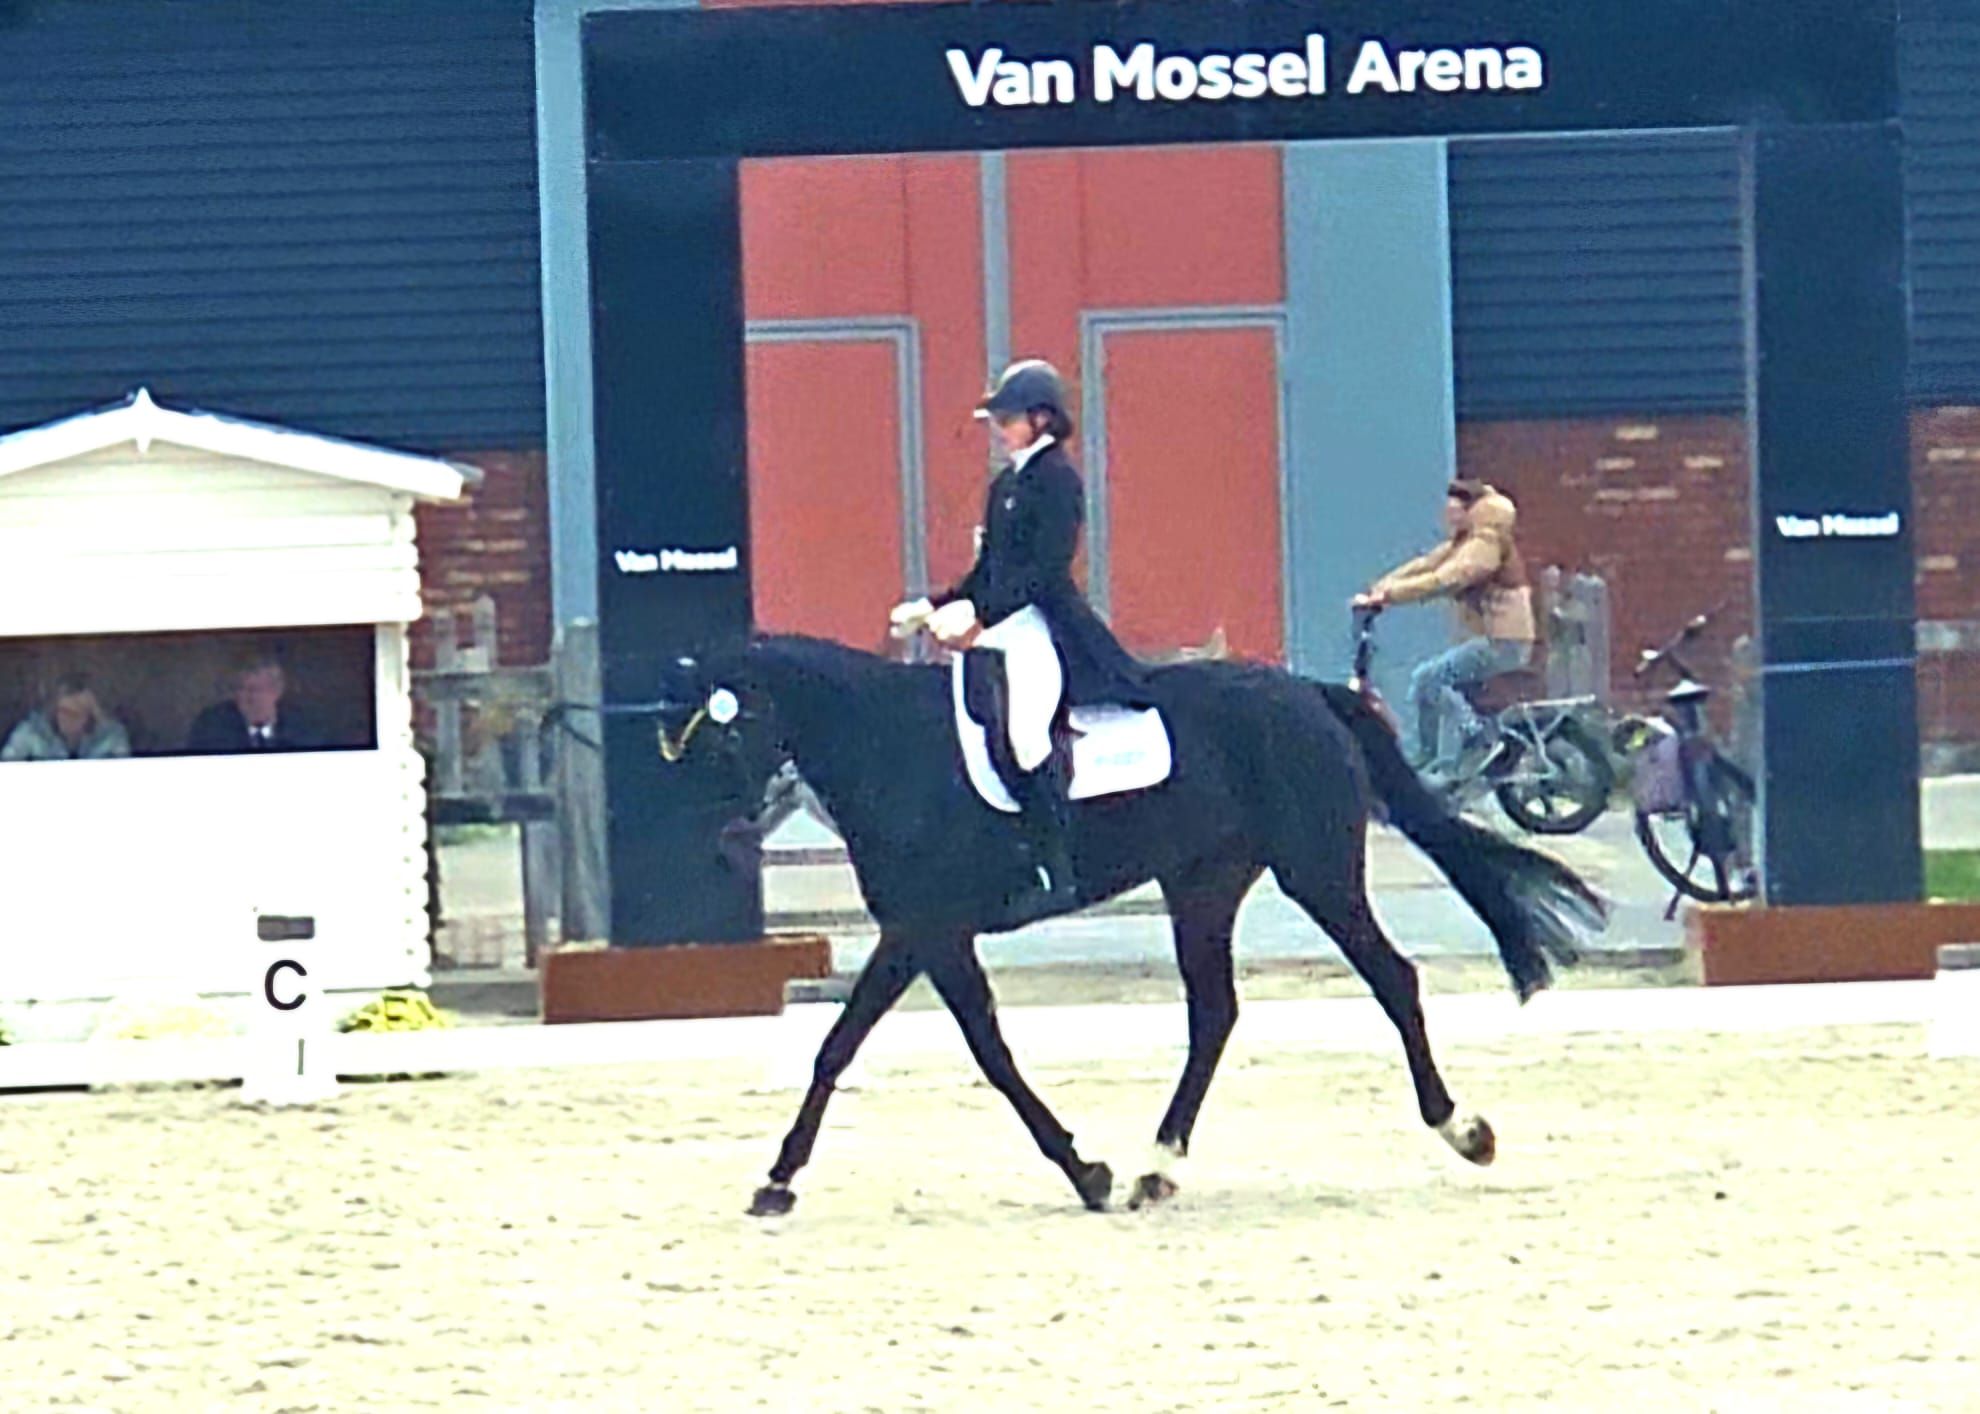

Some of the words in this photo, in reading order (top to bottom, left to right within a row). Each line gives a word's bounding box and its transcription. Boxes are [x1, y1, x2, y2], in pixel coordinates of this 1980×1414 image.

[946, 48, 1075, 106] Van
[1093, 34, 1326, 102] Mossel
[1346, 40, 1543, 94] Arena
[265, 960, 307, 1010] C
